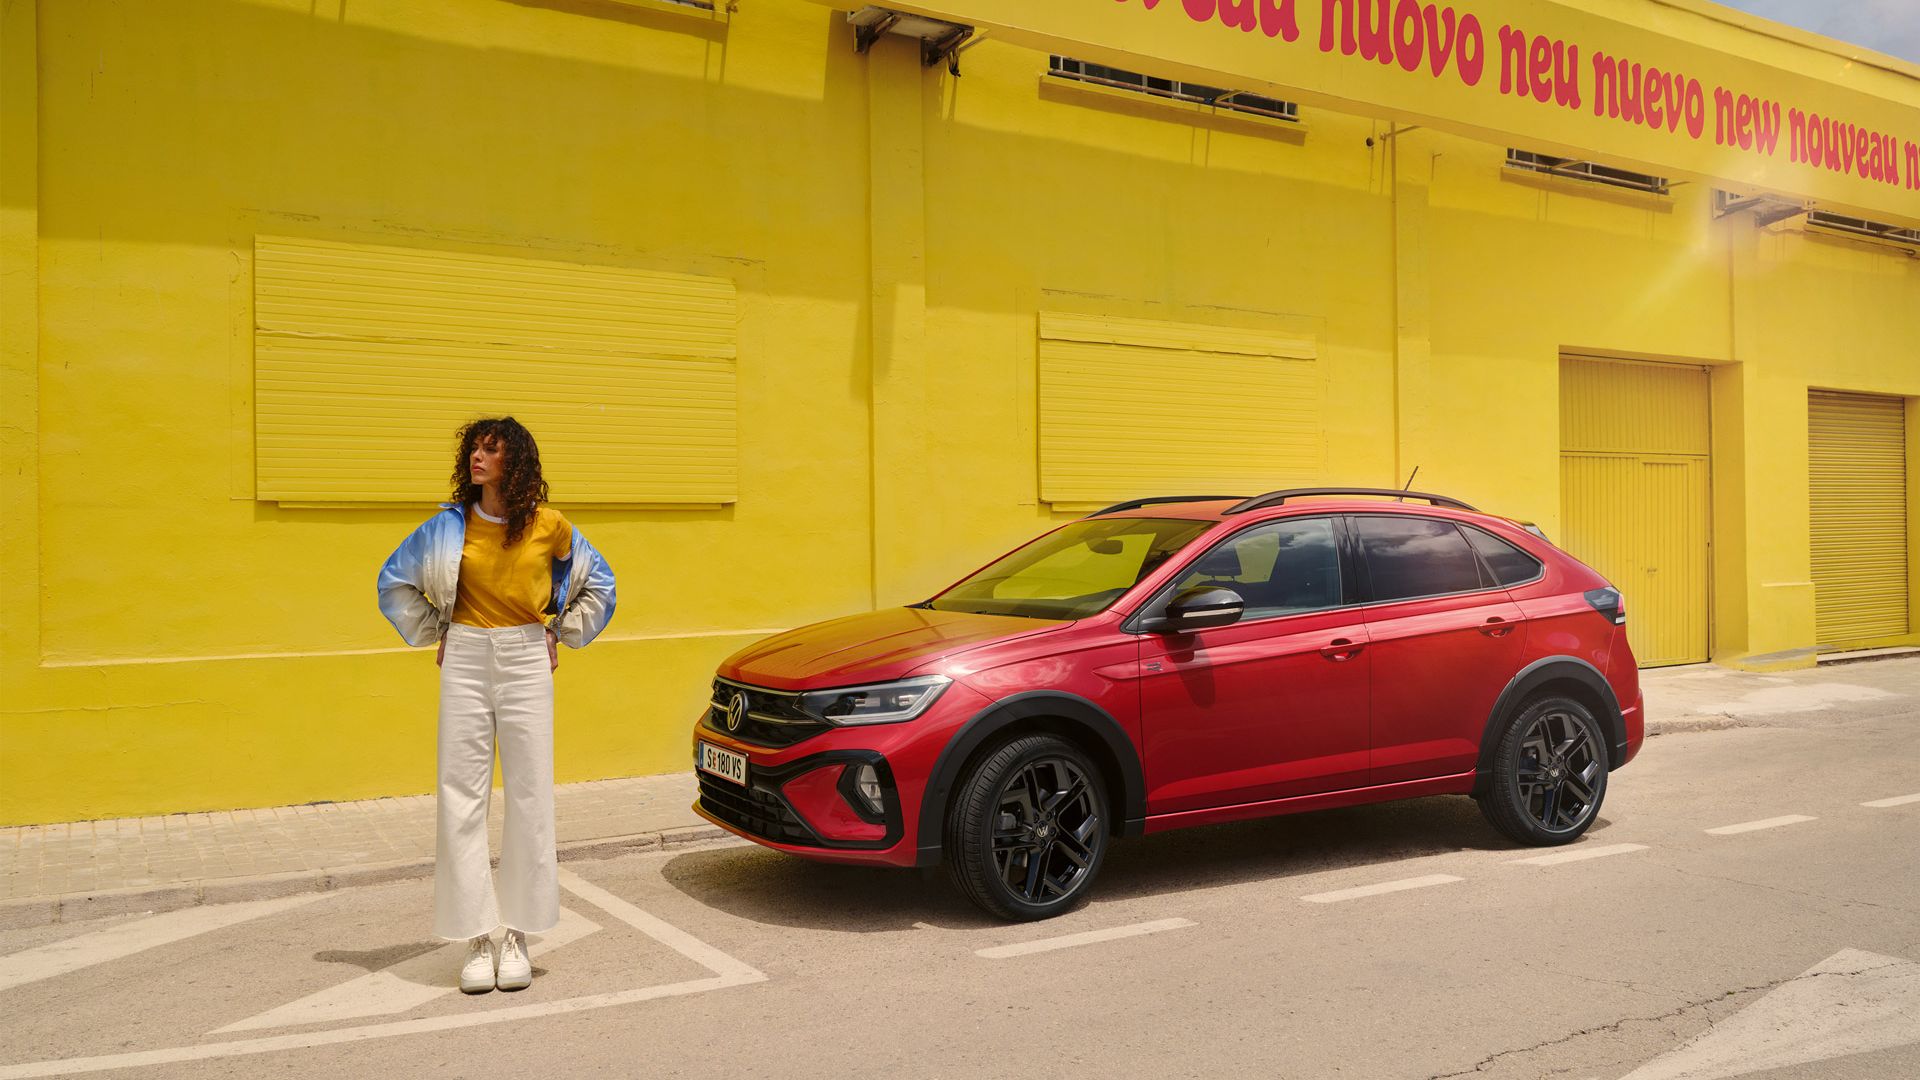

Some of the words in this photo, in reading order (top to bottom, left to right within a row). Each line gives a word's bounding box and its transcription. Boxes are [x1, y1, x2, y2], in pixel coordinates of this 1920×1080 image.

[1319, 0, 1485, 87] nuovo
[1498, 24, 1582, 110] neu
[1592, 51, 1705, 140] nuevo
[1714, 86, 1781, 157] new
[1788, 107, 1900, 187] nouveau
[1904, 141, 1920, 191] n
[707, 748, 712, 768] S
[717, 752, 731, 775] 180
[732, 756, 742, 780] VS
